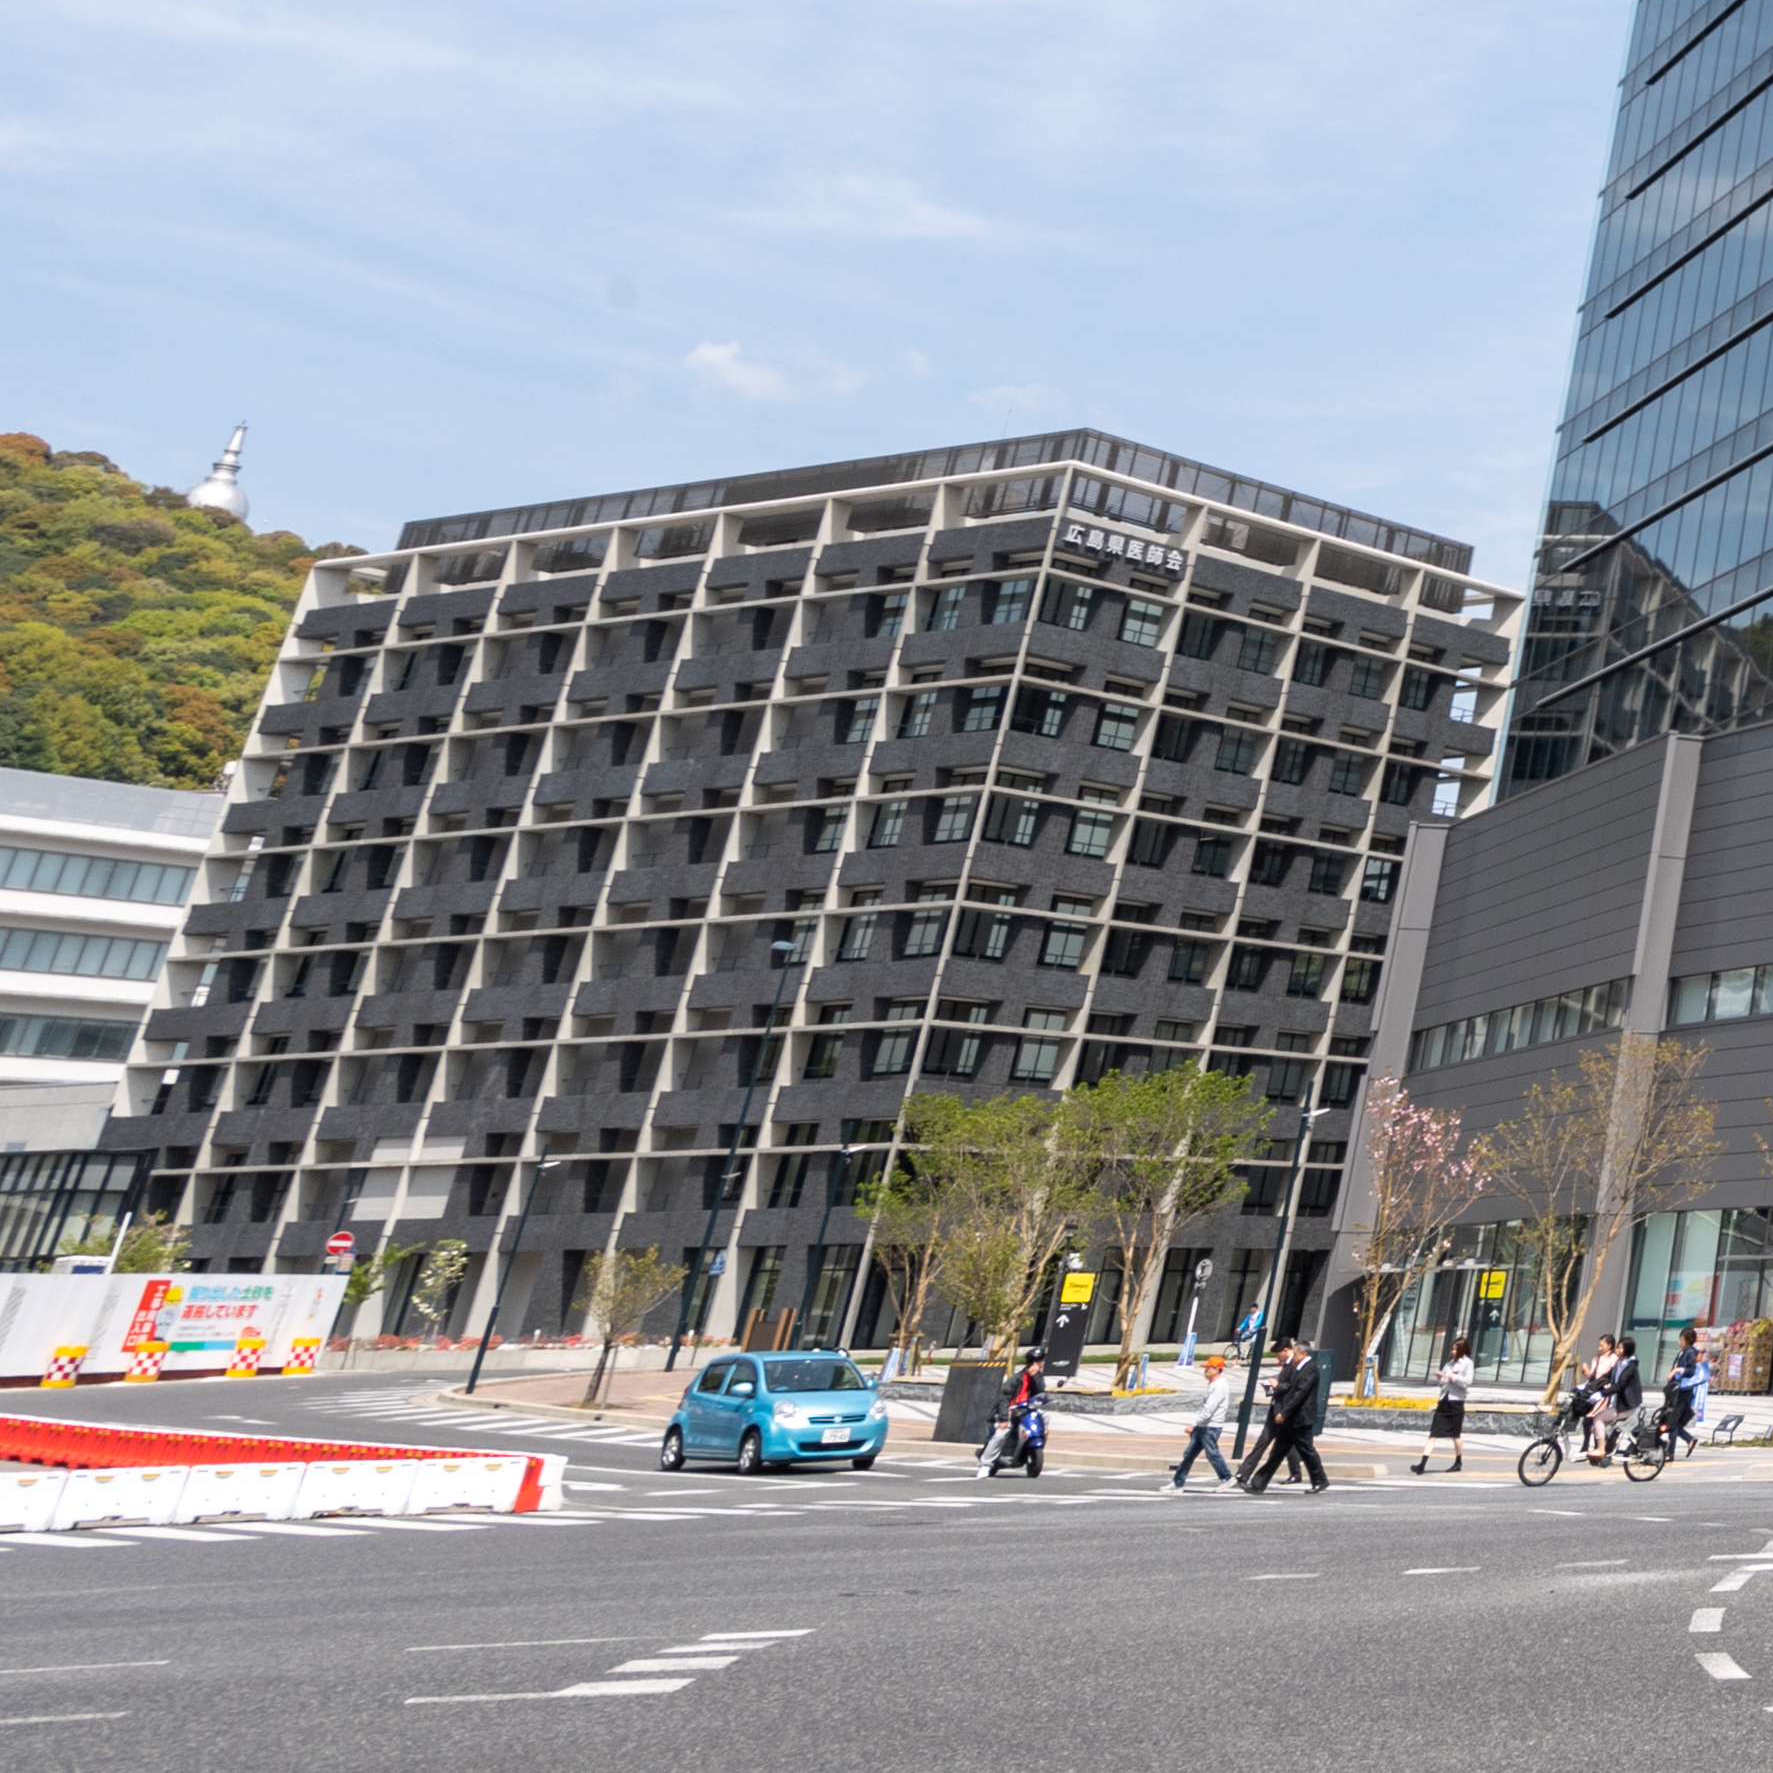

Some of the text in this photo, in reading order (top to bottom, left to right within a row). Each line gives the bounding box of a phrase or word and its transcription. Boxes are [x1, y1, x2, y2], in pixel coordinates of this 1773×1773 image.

[1063, 524, 1184, 571] 広島県医師会
